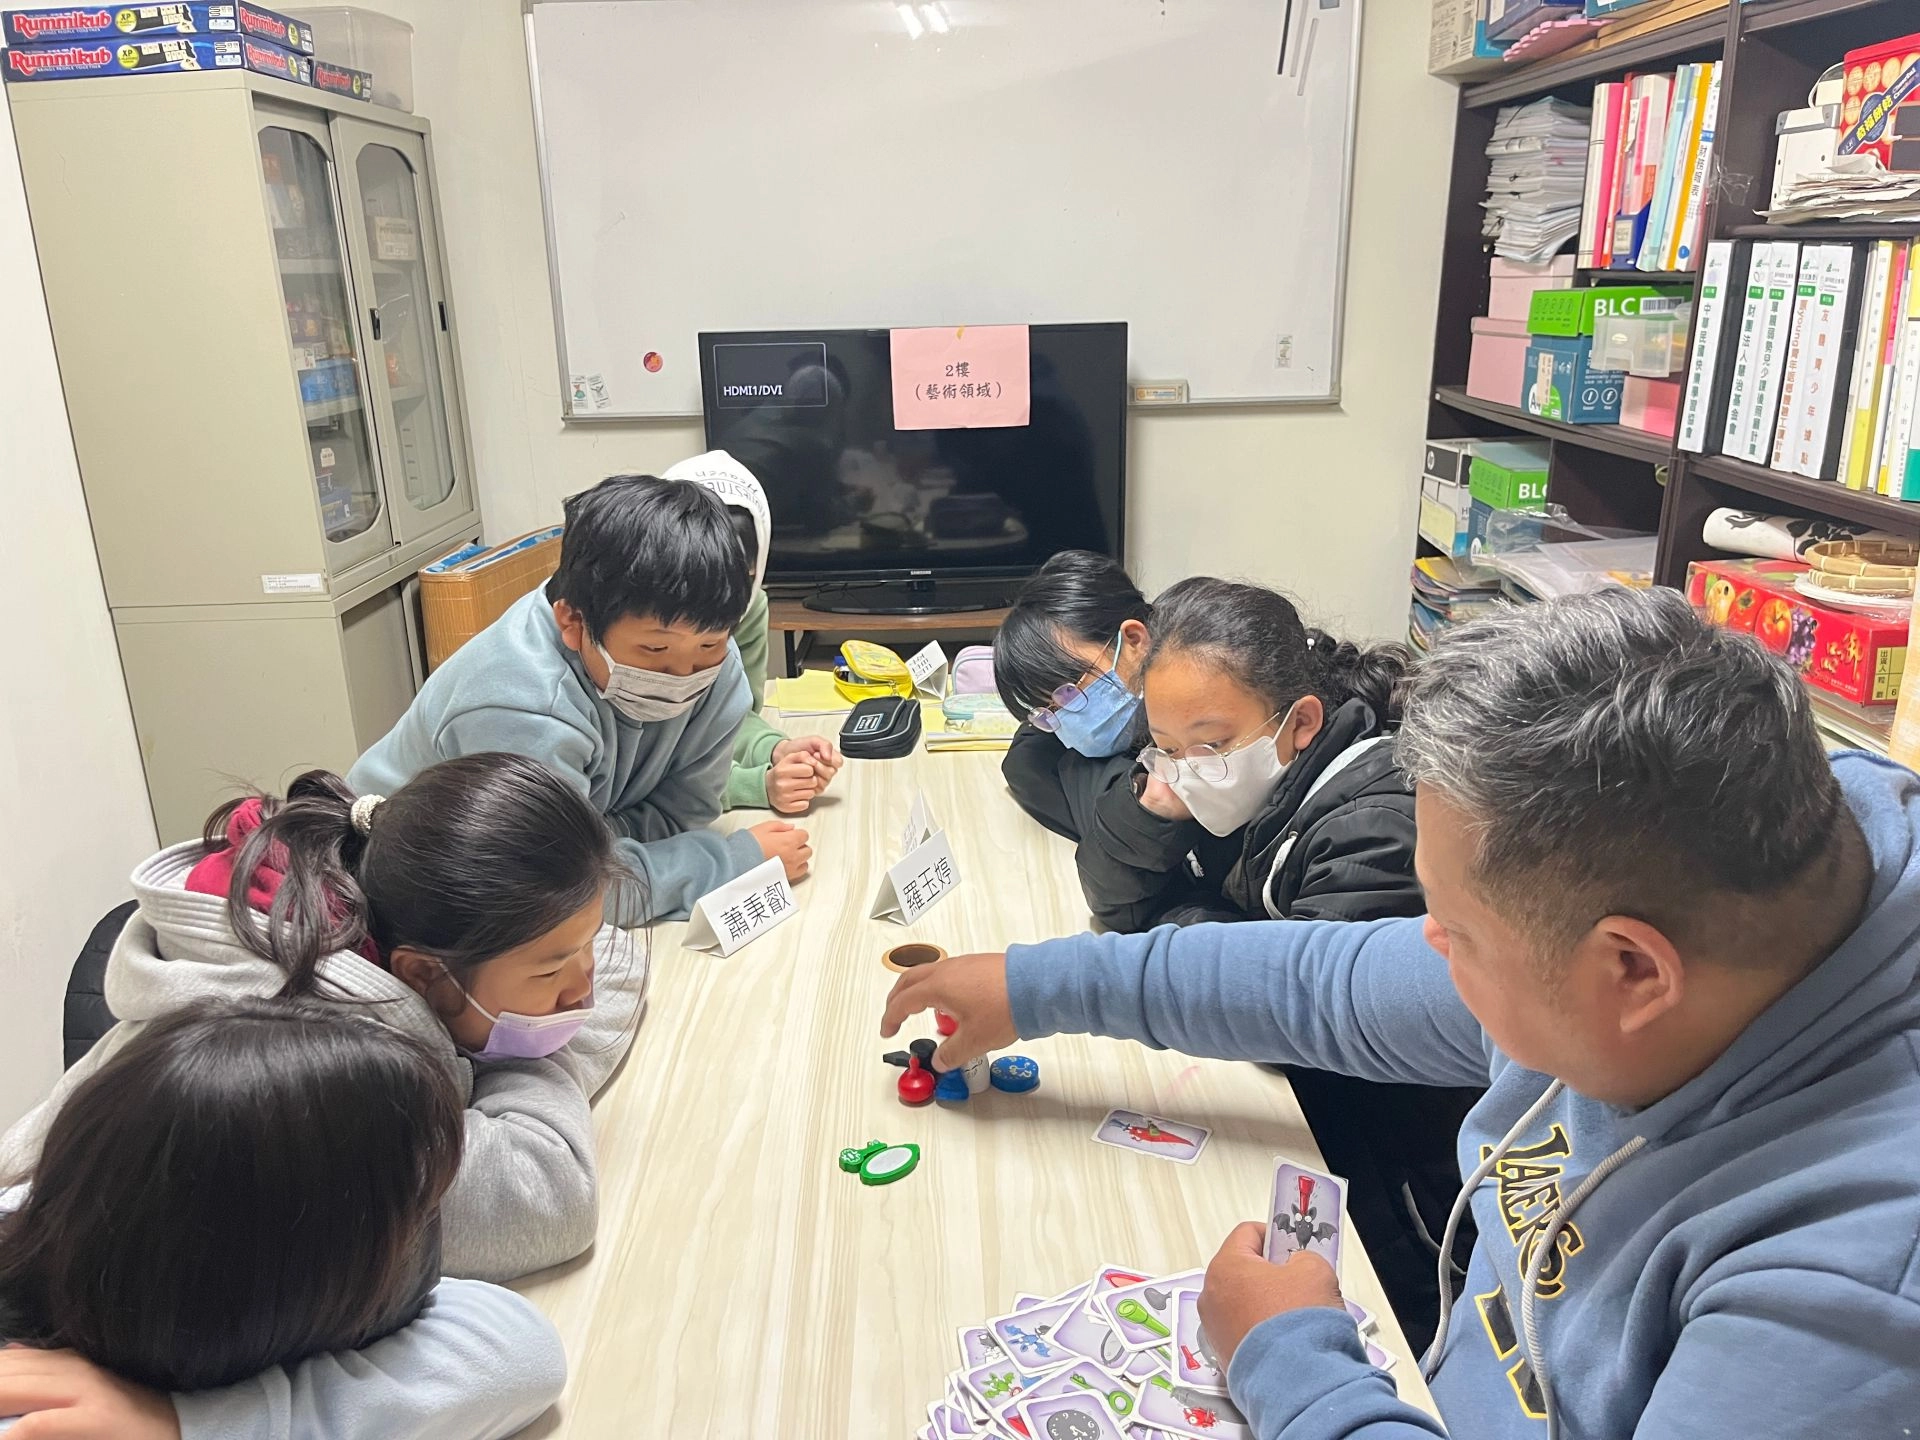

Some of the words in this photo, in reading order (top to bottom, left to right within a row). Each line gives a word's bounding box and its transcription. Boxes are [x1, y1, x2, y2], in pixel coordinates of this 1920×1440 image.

[12, 10, 112, 39] Rummikub
[240, 6, 286, 39] Rummikub
[8, 46, 113, 76] Rummikub
[246, 42, 287, 71] Rummikub
[315, 66, 352, 91] Rummikub
[1594, 298, 1636, 316] BLC
[945, 361, 971, 378] 2樓
[723, 385, 783, 397] HDMI1/DVI
[915, 381, 1002, 401] （藝術領域）
[902, 856, 952, 916] 羅玉婷
[720, 880, 791, 942] 蕭秉叡
